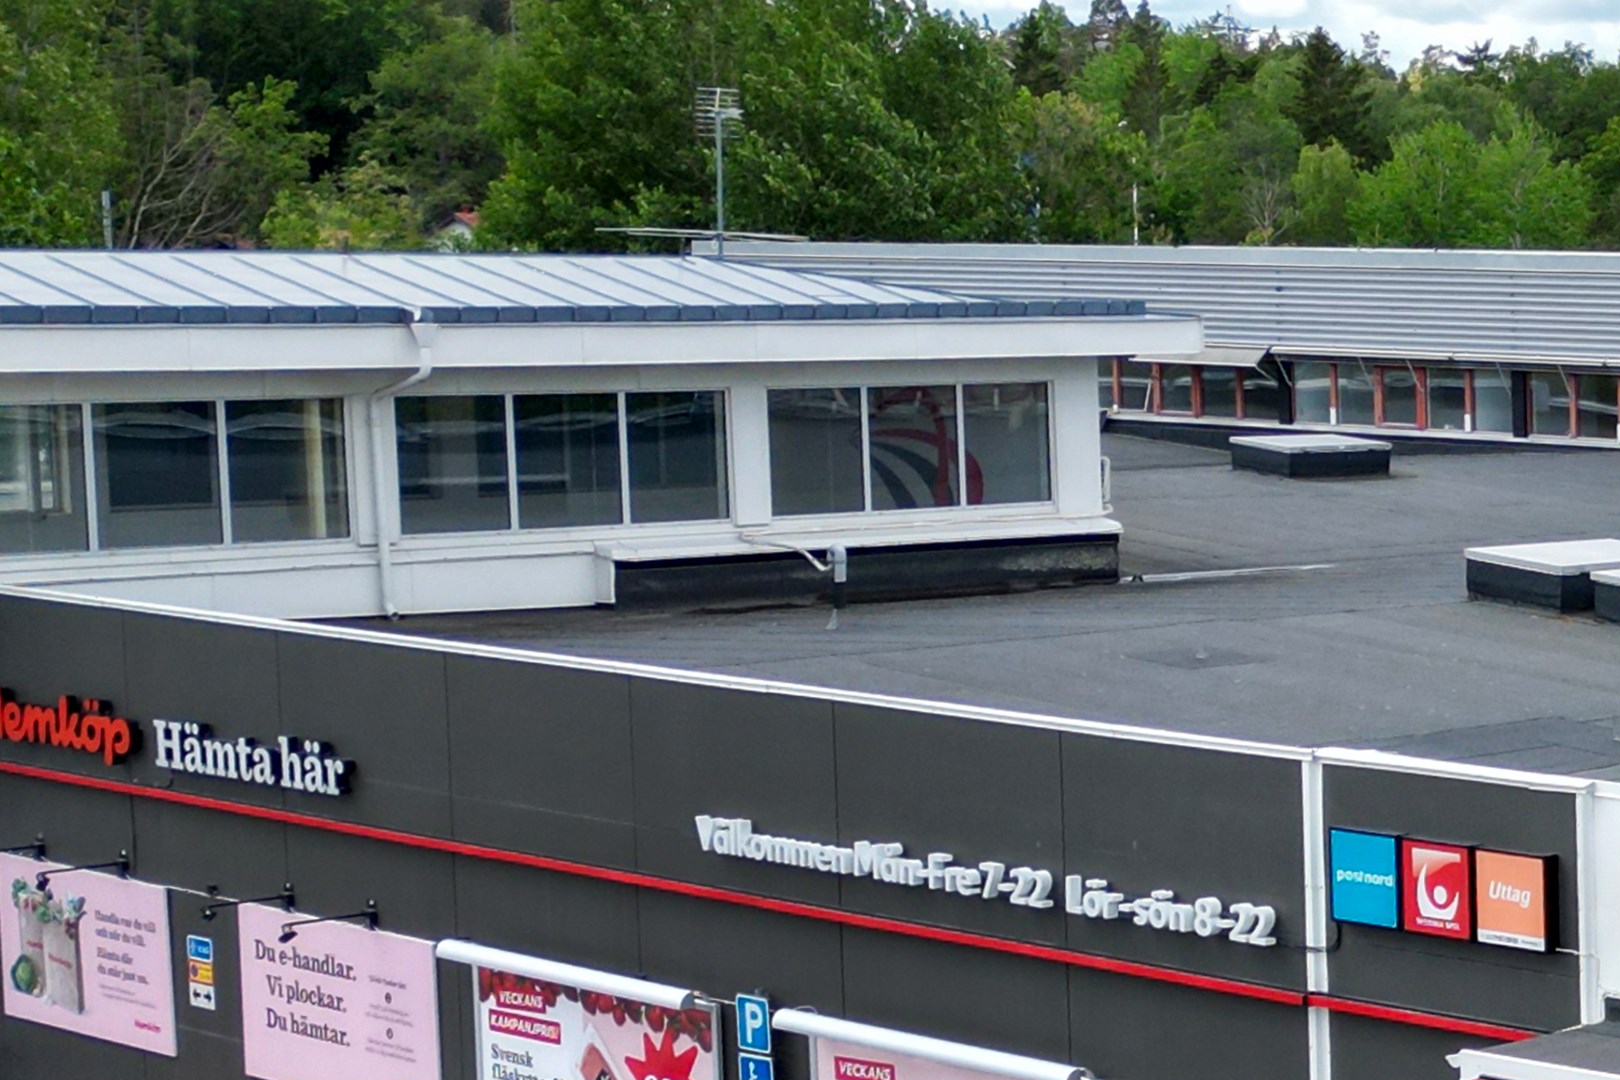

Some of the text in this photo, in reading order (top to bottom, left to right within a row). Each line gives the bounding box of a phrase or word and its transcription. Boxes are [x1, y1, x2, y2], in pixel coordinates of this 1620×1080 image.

[0, 688, 131, 766] emköp
[153, 719, 345, 796] Hämta här
[695, 815, 853, 874] Välkommen
[979, 861, 1054, 908] 7-22
[1194, 897, 1277, 946] 8-22
[1336, 868, 1394, 888] postnord
[1488, 880, 1531, 908] Uttag
[254, 939, 357, 981] Du e-handlar.
[266, 974, 284, 998] Vi
[286, 980, 347, 1013] plockar.
[266, 1008, 287, 1031] Du
[290, 1013, 351, 1047] hämtar.
[745, 1001, 763, 1044] P
[491, 1043, 534, 1068] Svensk
